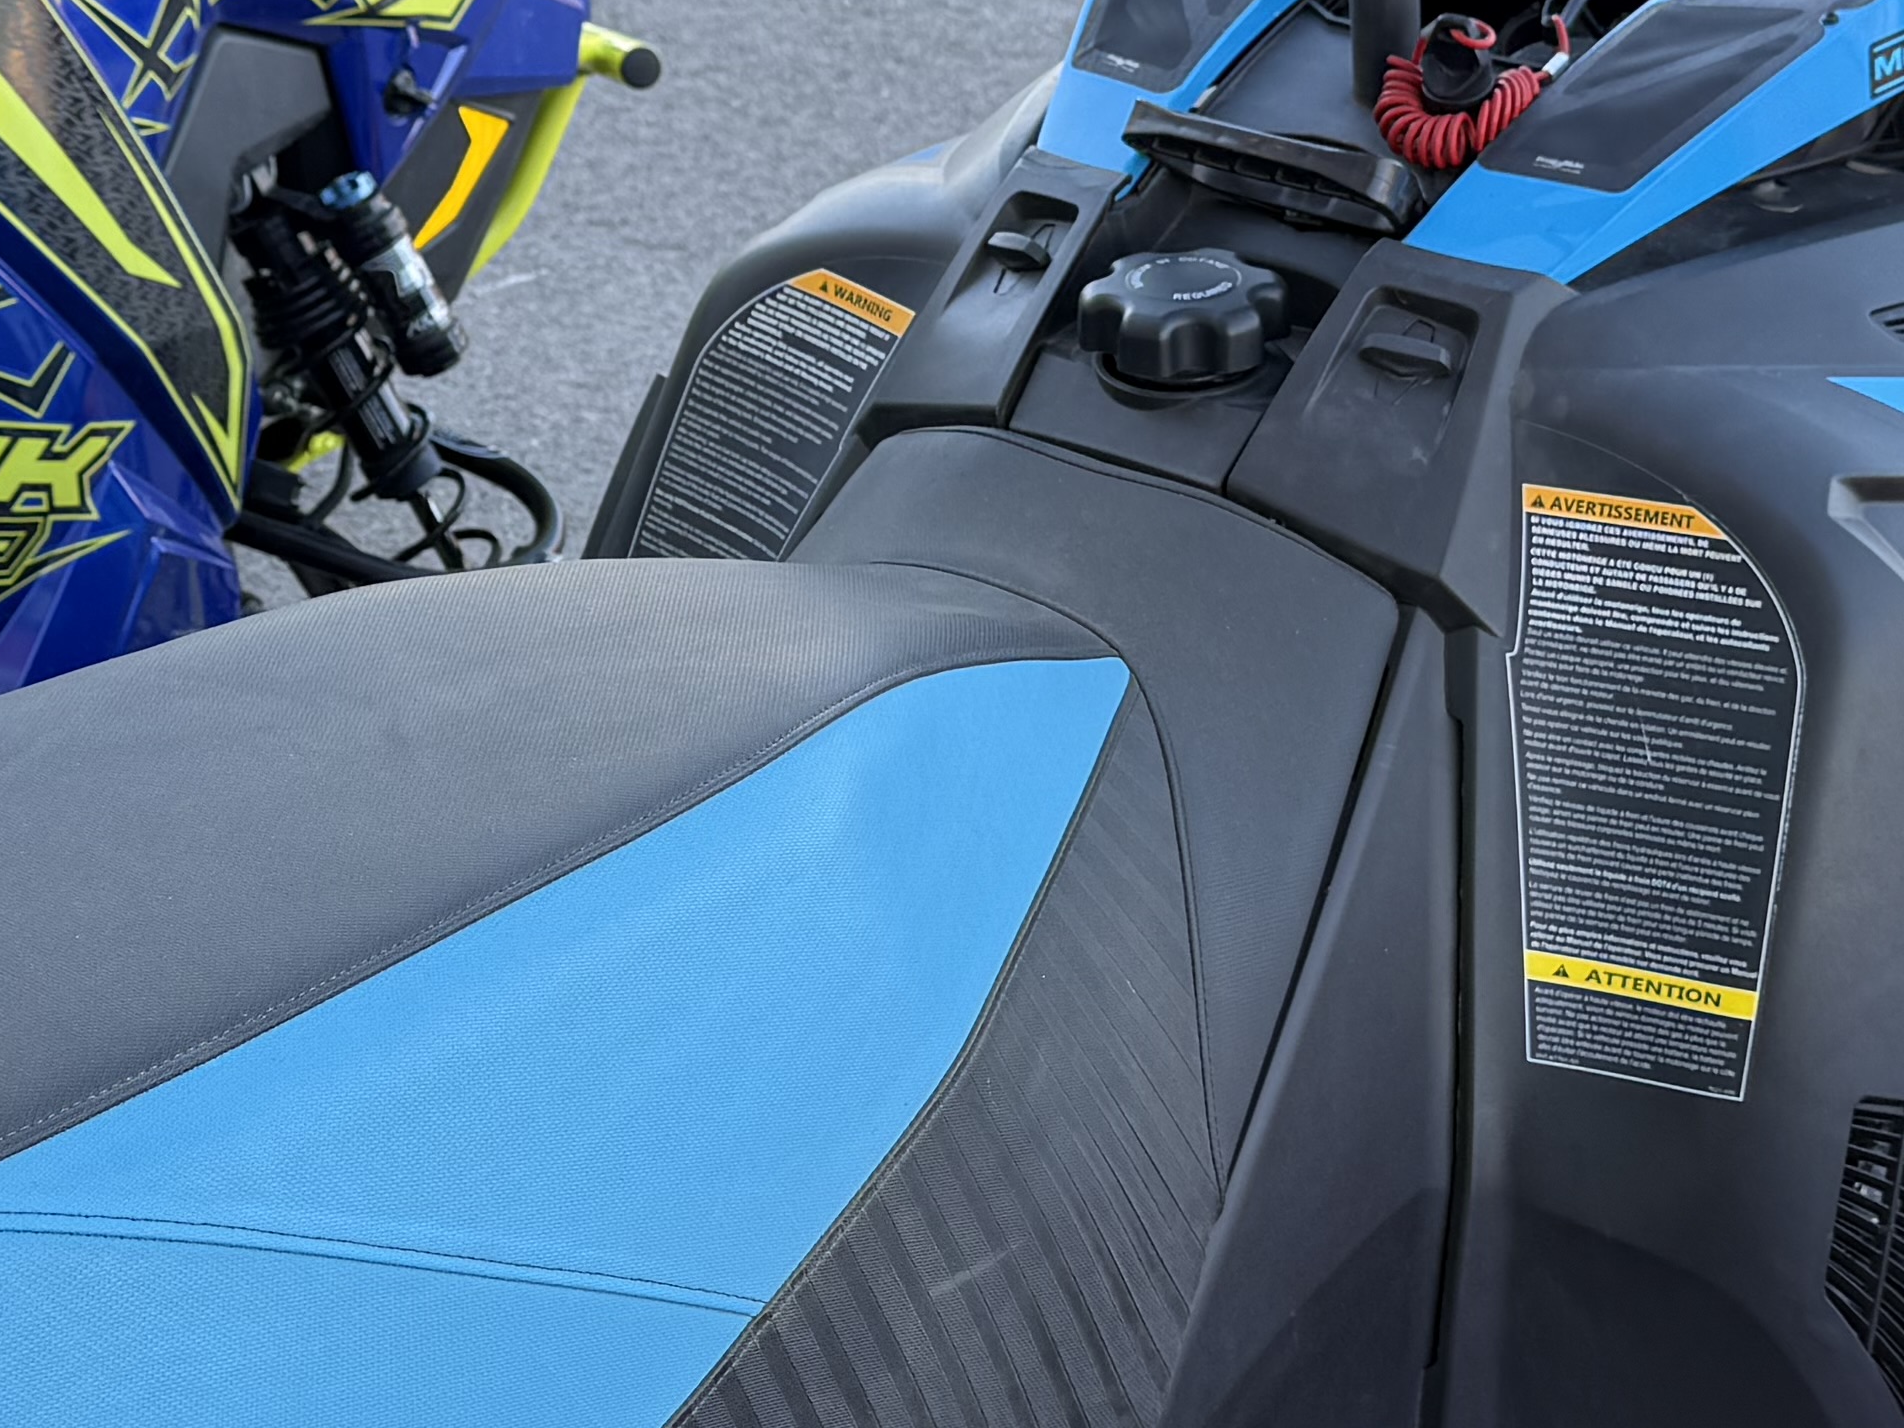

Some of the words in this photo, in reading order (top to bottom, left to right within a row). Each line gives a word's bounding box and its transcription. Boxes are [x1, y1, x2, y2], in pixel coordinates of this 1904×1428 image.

[833, 283, 894, 323] WARNING
[1173, 281, 1233, 301] REQUIRED
[1549, 494, 1696, 531] AVERTISSEMENT
[1584, 966, 1723, 1009] ATTENTION
